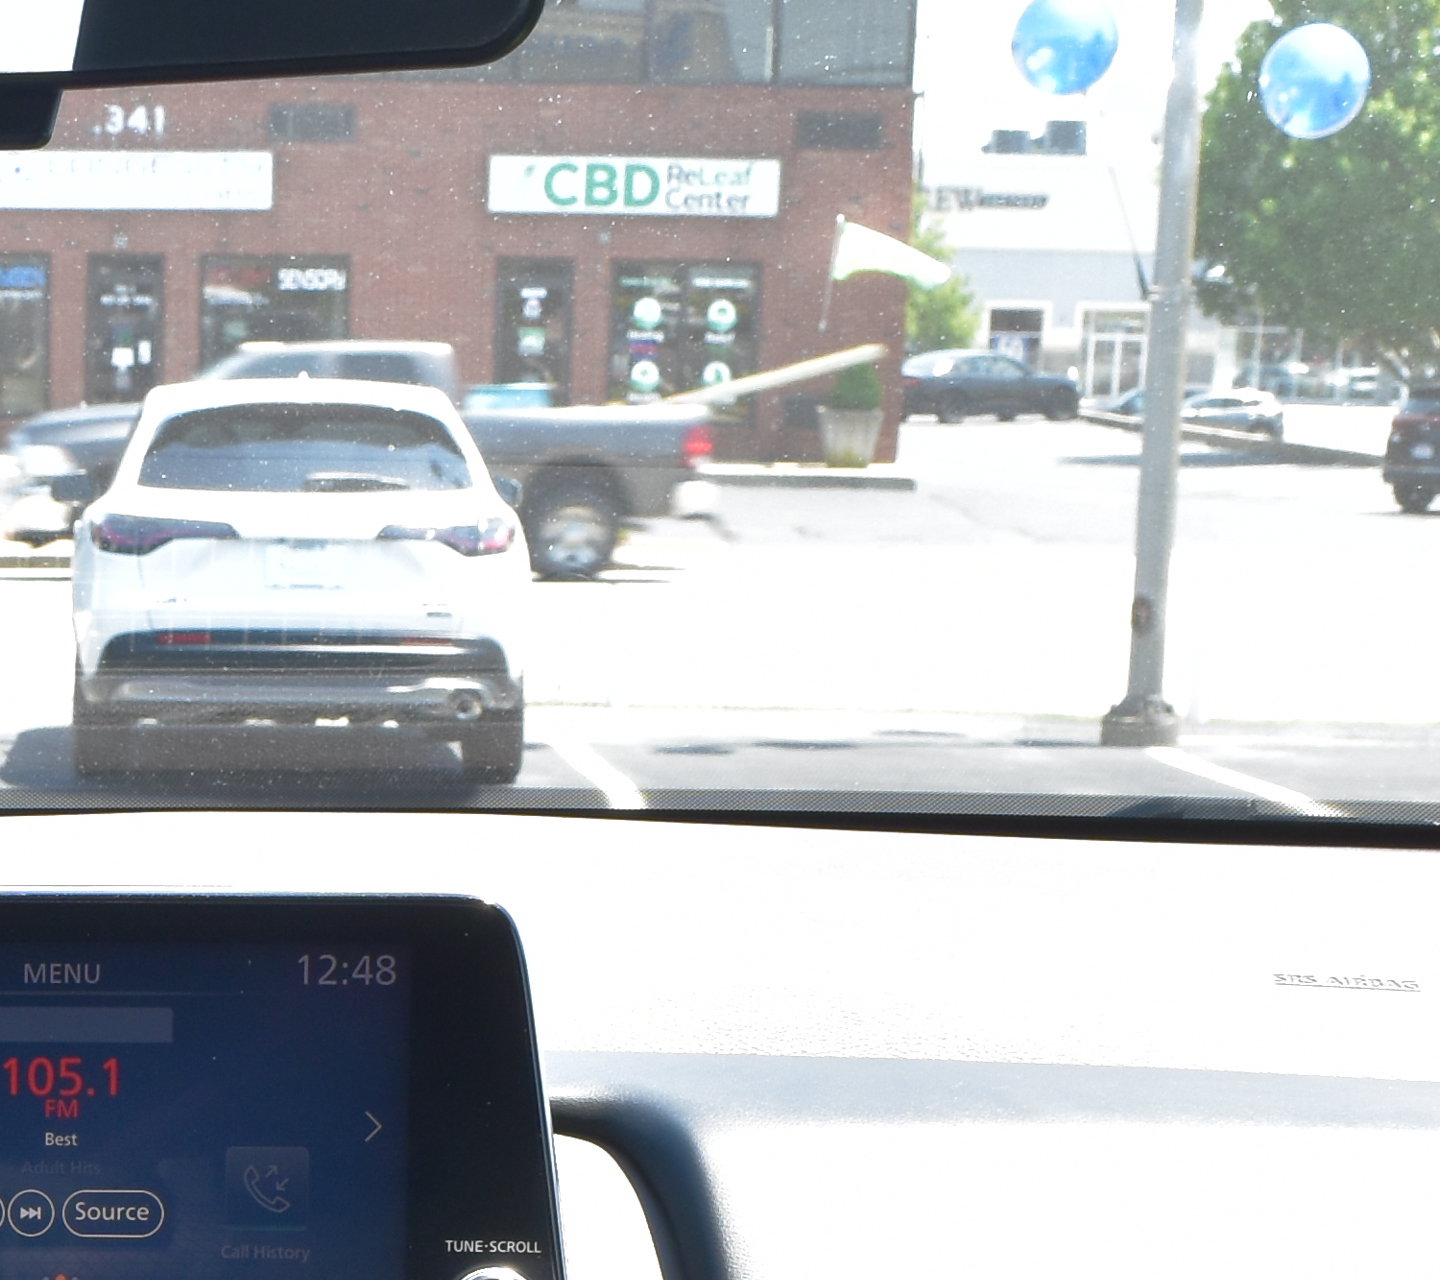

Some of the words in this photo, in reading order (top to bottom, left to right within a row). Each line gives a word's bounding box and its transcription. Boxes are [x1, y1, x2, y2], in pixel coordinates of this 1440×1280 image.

[543, 163, 661, 207] CBD
[667, 163, 752, 186] ReLeaf
[665, 187, 750, 210] Center
[23, 962, 101, 985] MENU
[296, 954, 397, 987] 12:48
[2, 1056, 120, 1097] 105.1
[44, 1100, 79, 1118] FM
[44, 1130, 78, 1147] Best
[75, 1201, 149, 1222] Source
